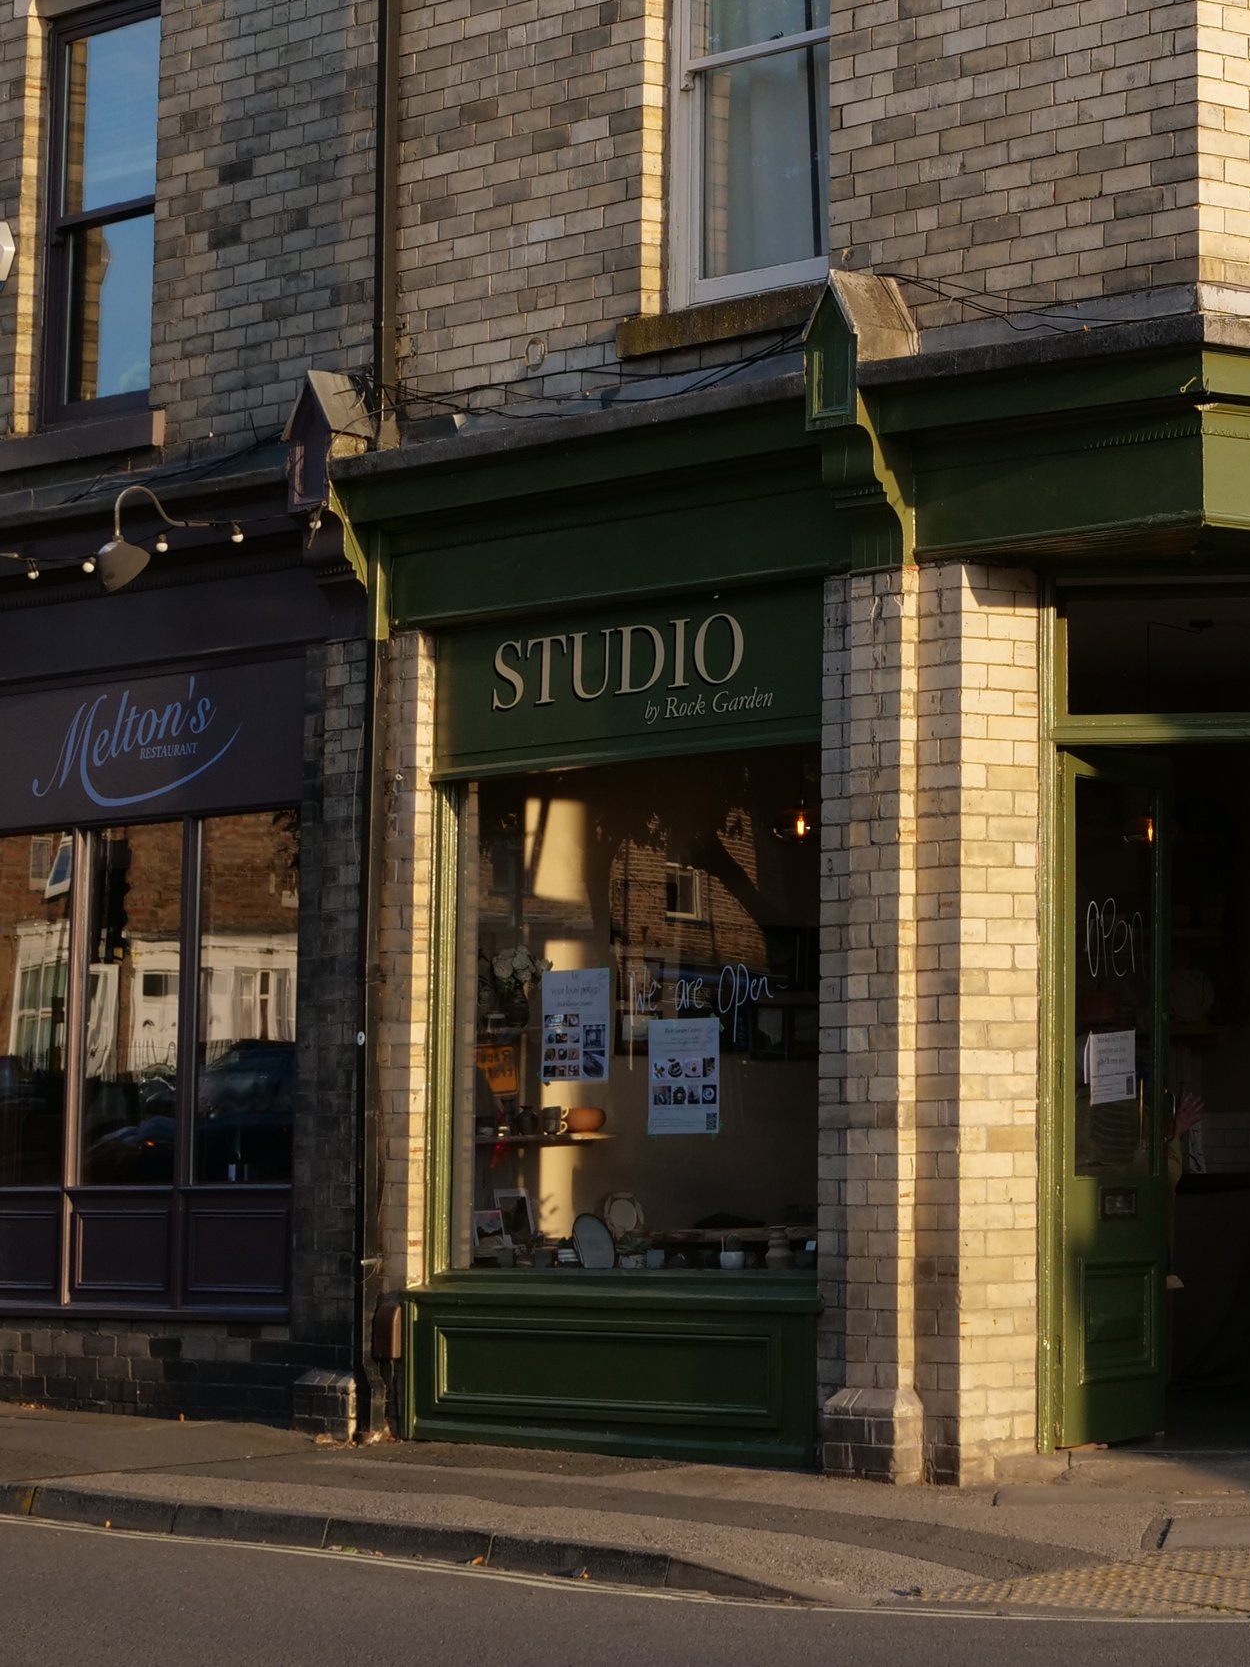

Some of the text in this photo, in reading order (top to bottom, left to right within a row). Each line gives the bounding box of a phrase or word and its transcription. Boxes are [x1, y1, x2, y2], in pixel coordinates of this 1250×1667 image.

[492, 613, 744, 710] STUDIO
[644, 686, 773, 724] by Rock Garden
[32, 675, 236, 805] Melton's
[139, 741, 199, 760] RESTAURANT
[632, 965, 662, 1014] We
[674, 977, 705, 1010] are
